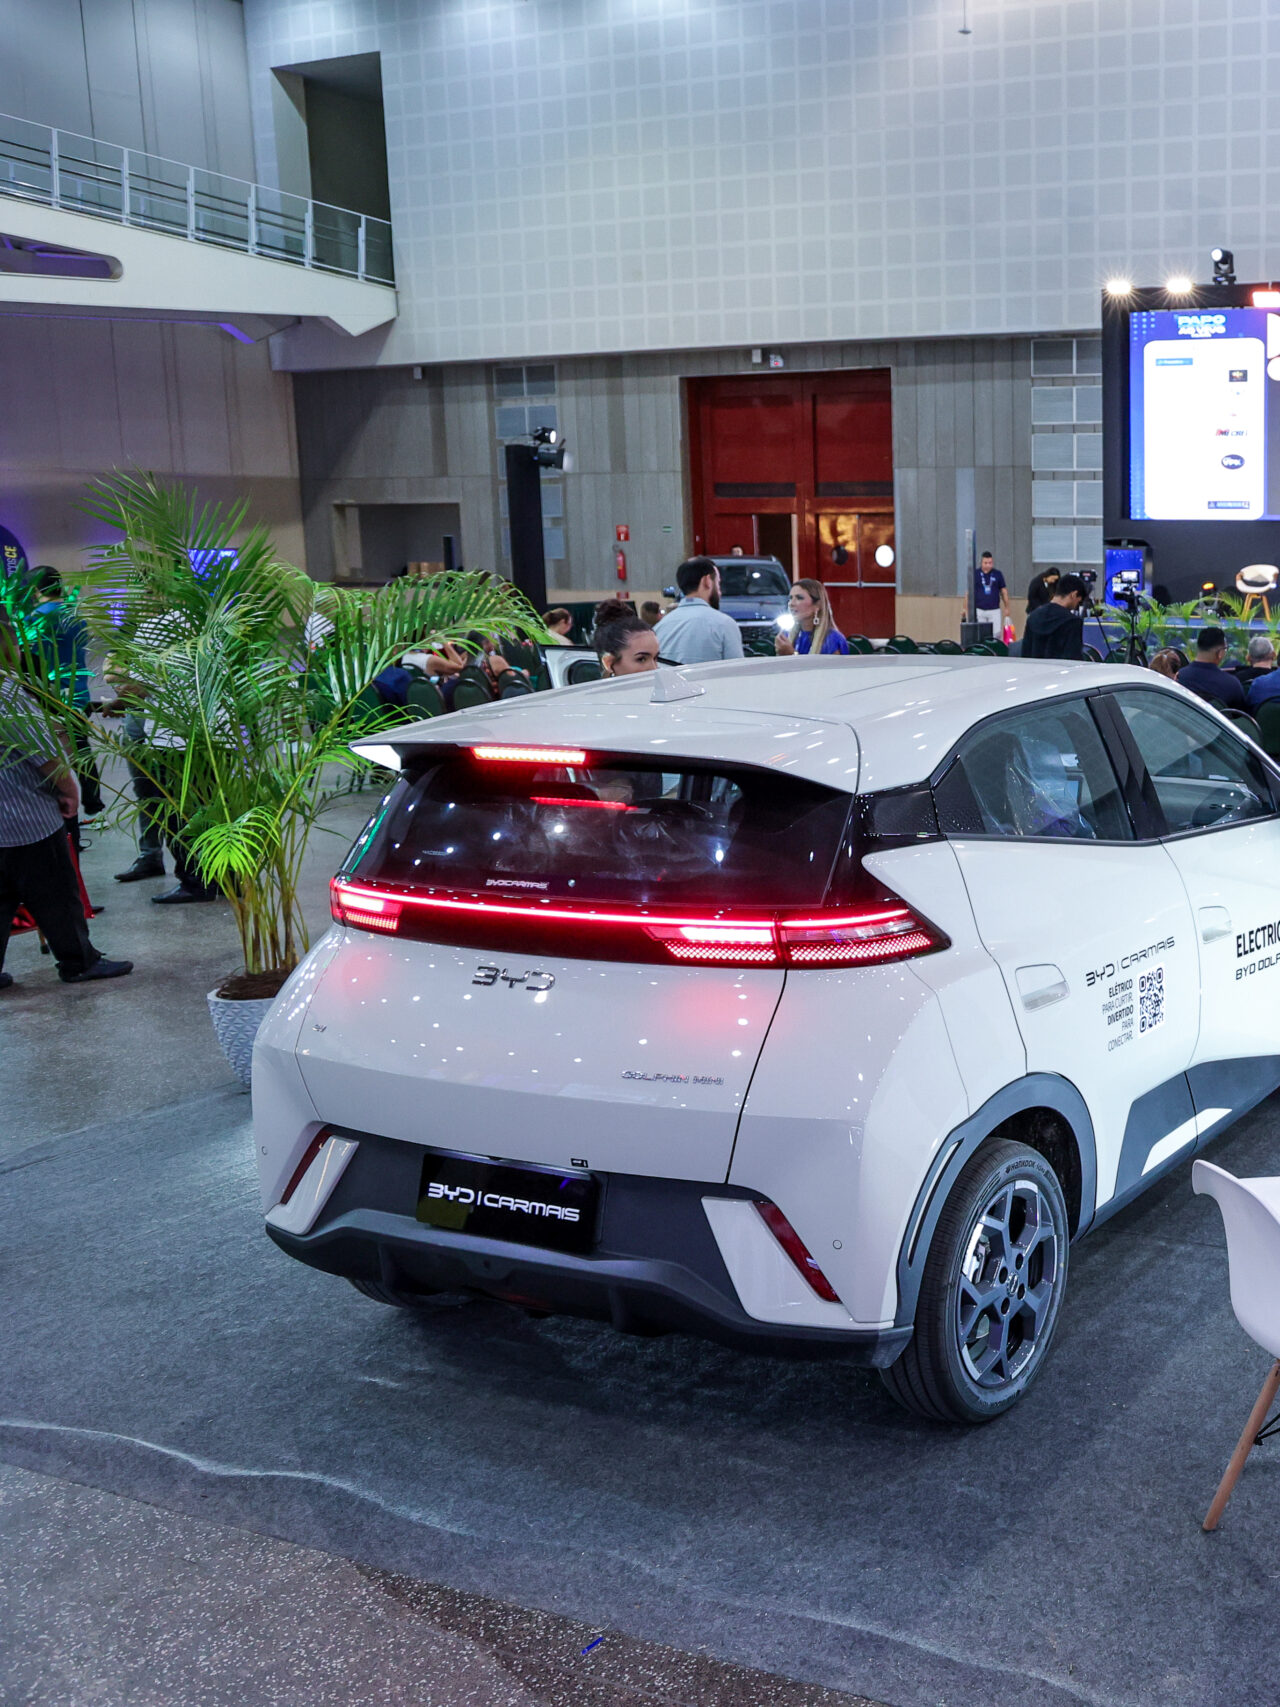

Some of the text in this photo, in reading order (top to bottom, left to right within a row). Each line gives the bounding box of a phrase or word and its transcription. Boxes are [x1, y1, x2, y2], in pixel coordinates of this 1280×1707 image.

[1178, 315, 1226, 326] PAPO
[1086, 936, 1176, 987] BYD CARMAIS
[472, 966, 556, 992] BYD
[1235, 962, 1256, 981] BYD
[1108, 979, 1134, 998] ELÉTRICO
[1102, 999, 1115, 1015] PARA
[1107, 1004, 1134, 1026] DIVERTIDO
[1121, 1017, 1134, 1031] PARA
[621, 1071, 689, 1084] DOLPHIN
[428, 1182, 581, 1222] BYD CARMAIS
